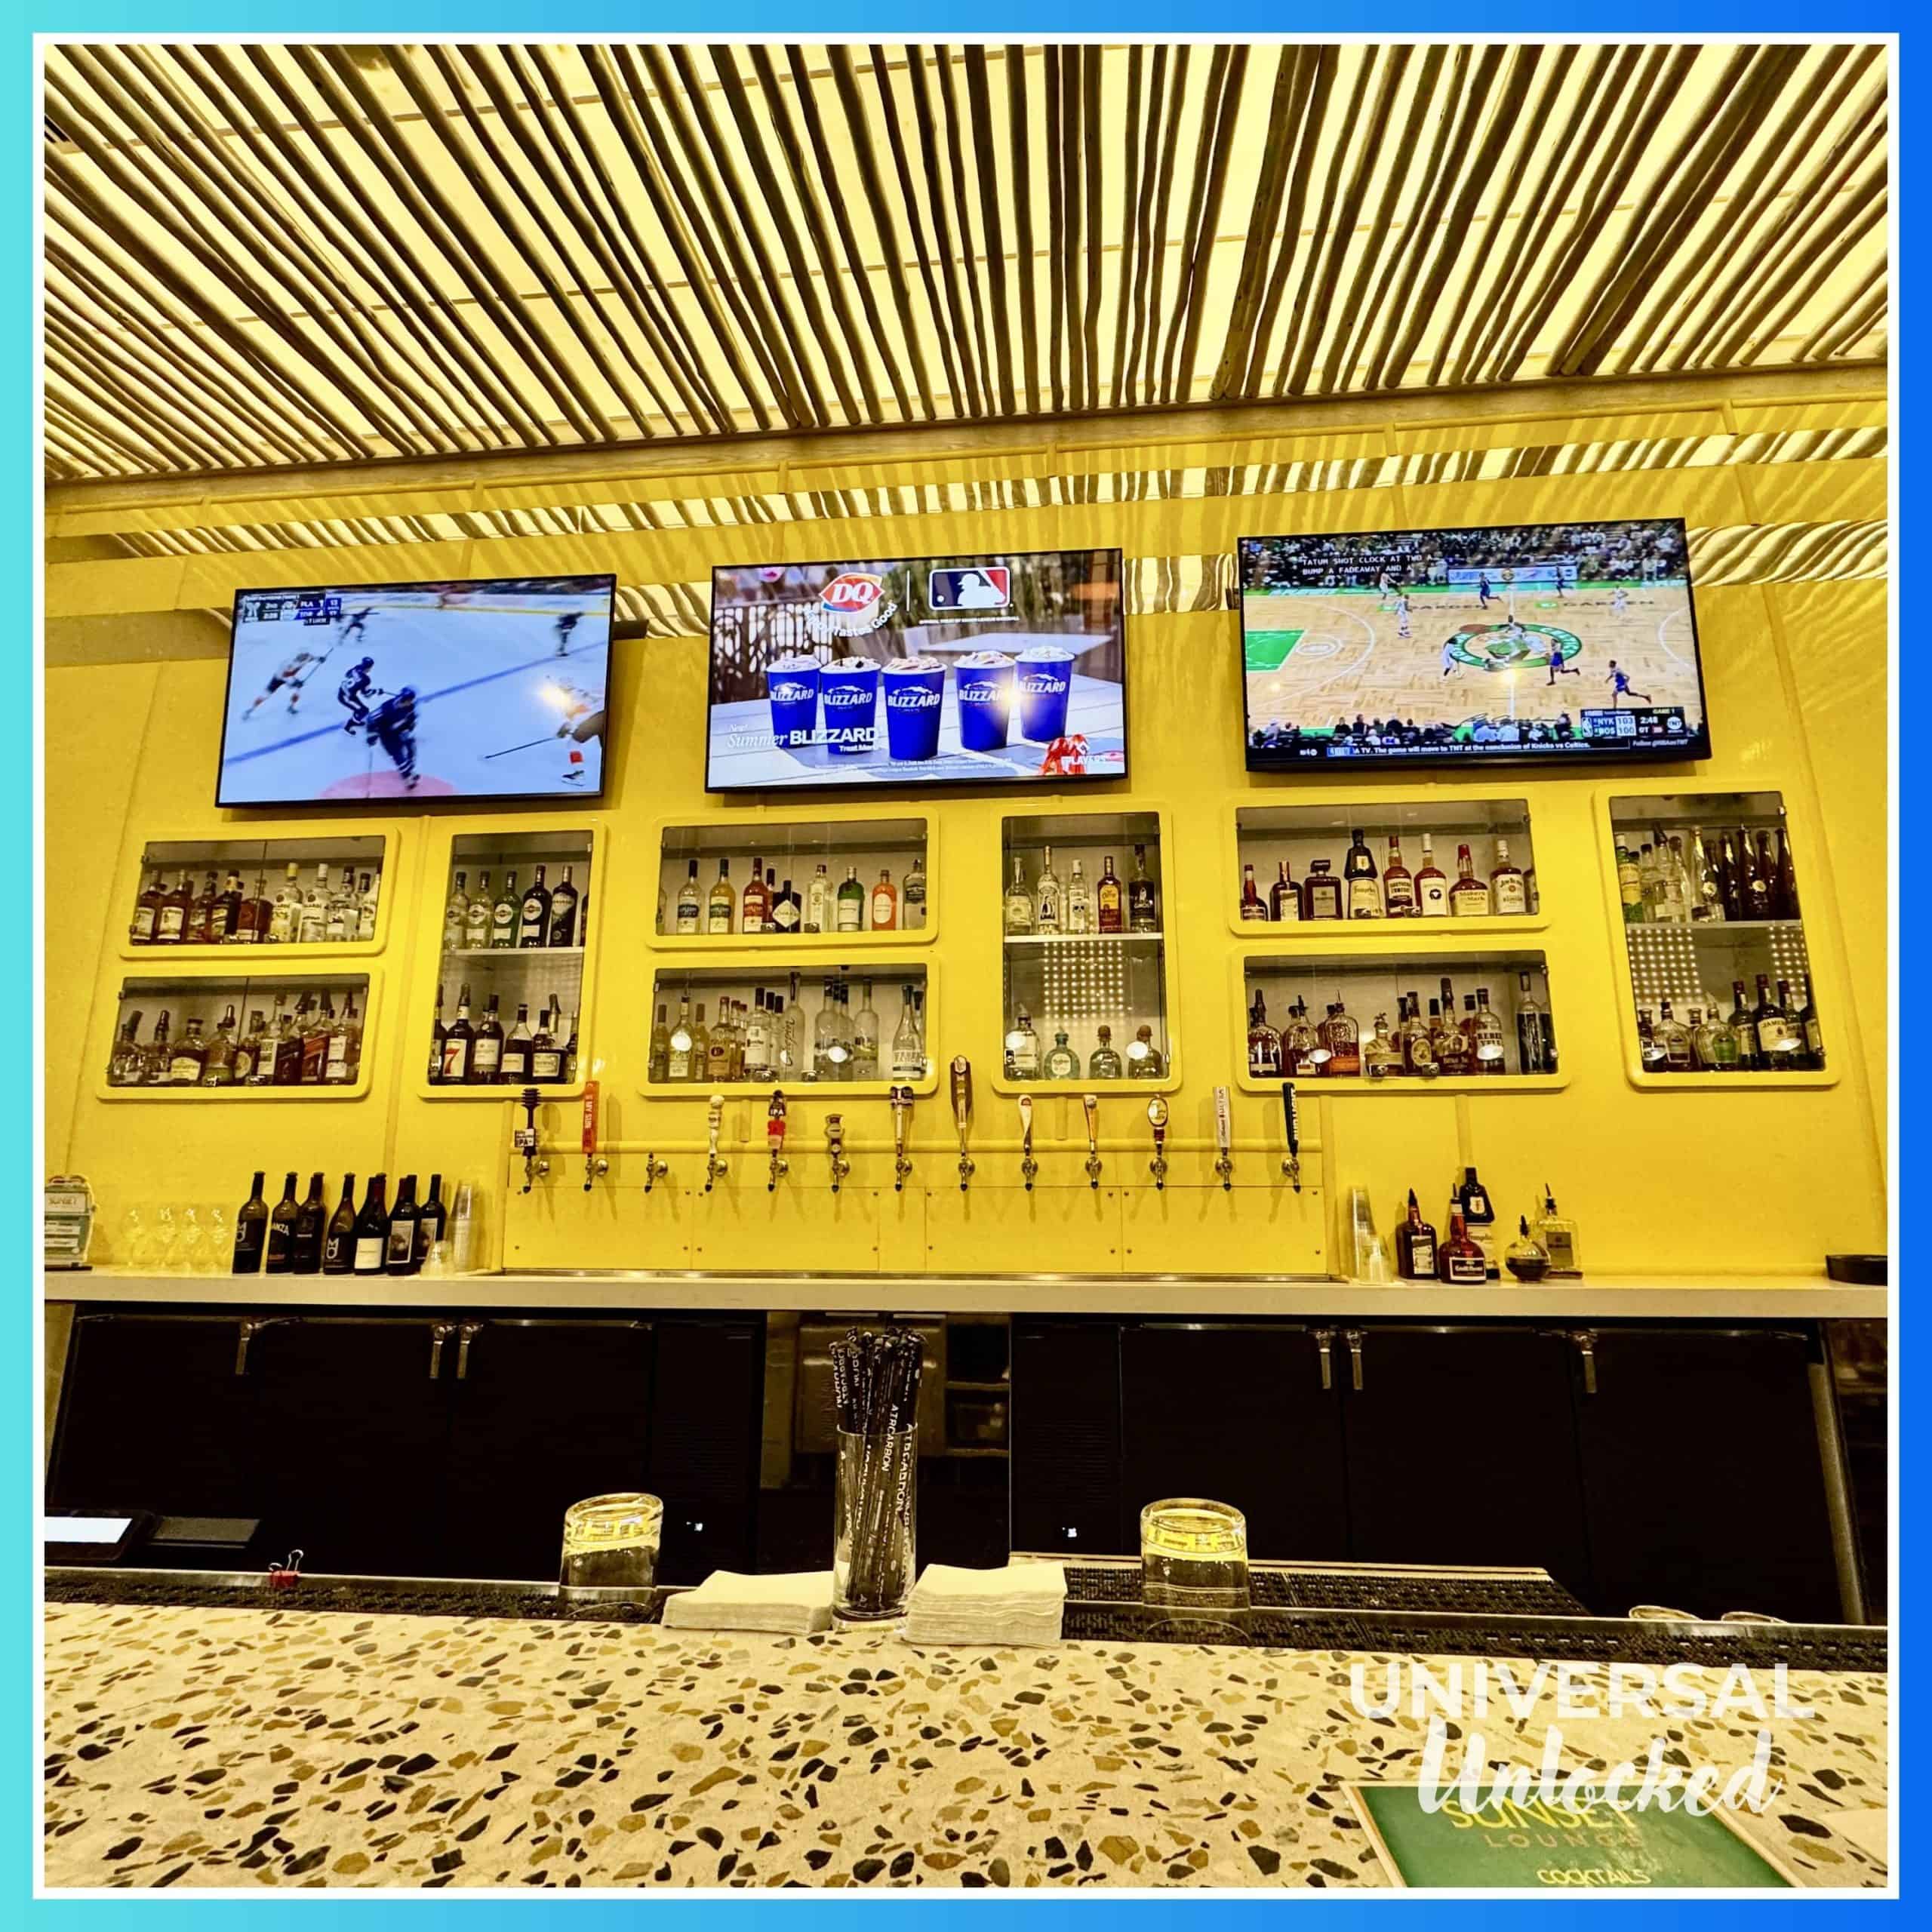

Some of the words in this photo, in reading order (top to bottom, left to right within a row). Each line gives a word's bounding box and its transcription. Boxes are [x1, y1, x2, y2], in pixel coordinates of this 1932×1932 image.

[832, 583, 873, 603] DQ
[871, 600, 898, 628] Good
[823, 692, 873, 706] BLIZZARD
[888, 694, 941, 708] BLIZZARD
[1617, 716, 1634, 724] 103
[728, 732, 788, 749] Summer
[789, 727, 880, 746] BLIZZARD
[444, 1048, 460, 1075] 7
[1441, 1795, 1638, 1829] SUNSET
[1482, 1834, 1642, 1848] LOUNGE
[1537, 1869, 1652, 1884] COCKTAILS
